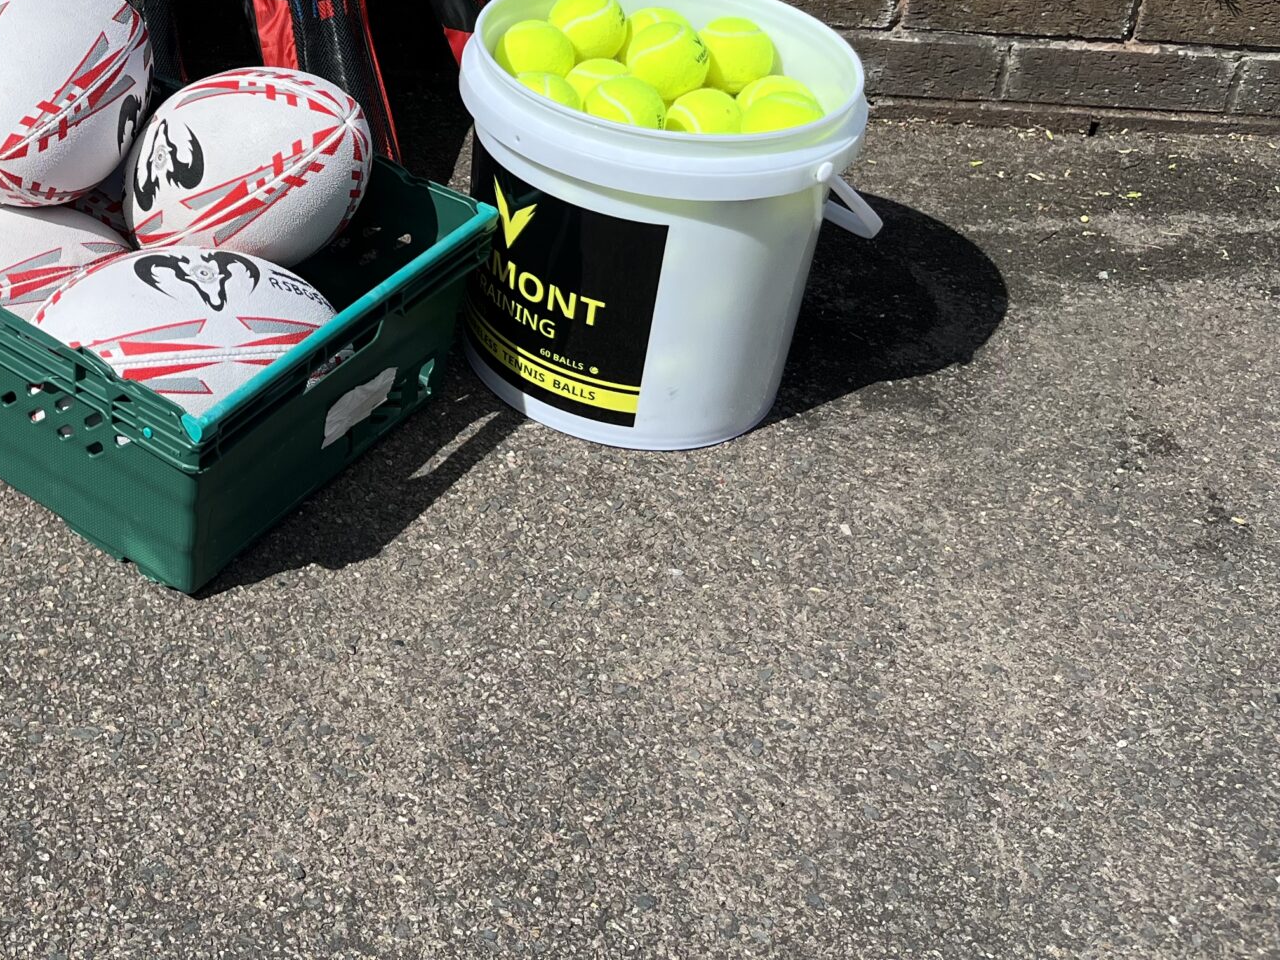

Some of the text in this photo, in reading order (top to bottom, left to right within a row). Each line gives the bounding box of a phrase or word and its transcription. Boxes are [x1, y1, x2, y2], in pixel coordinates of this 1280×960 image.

[487, 249, 606, 327] MONT
[502, 349, 546, 383] TENNIS
[551, 378, 597, 402] BALLS
[539, 347, 585, 372] 60 BALLS
